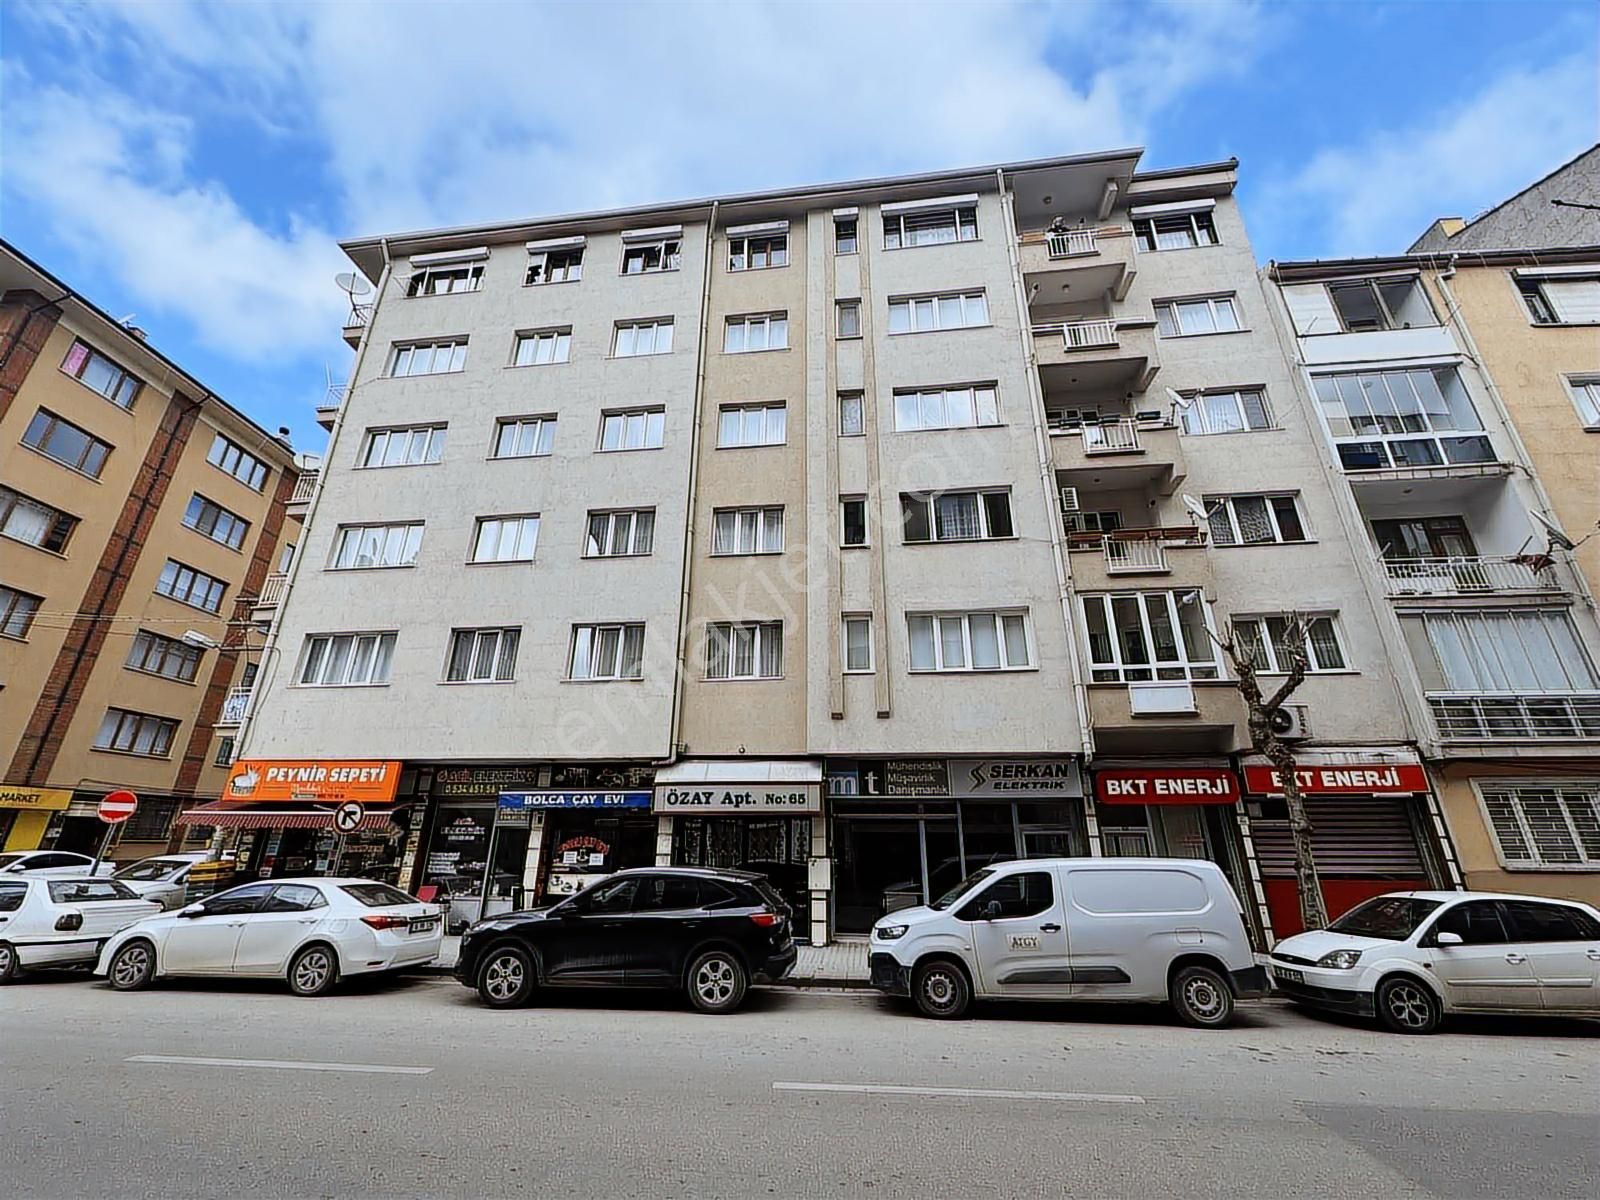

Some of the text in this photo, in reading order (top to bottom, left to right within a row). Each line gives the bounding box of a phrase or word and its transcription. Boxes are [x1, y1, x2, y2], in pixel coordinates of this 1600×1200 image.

[266, 764, 387, 783] PEYNİR SEPETİ
[989, 763, 1069, 779] SERKAN
[1320, 766, 1401, 788] ENERJİ
[1106, 774, 1230, 796] BKT ENERJİ
[523, 795, 565, 806] BOLCA
[572, 795, 597, 807] ÇAY
[666, 788, 714, 806] ÖZAY
[721, 791, 757, 808] Apt.
